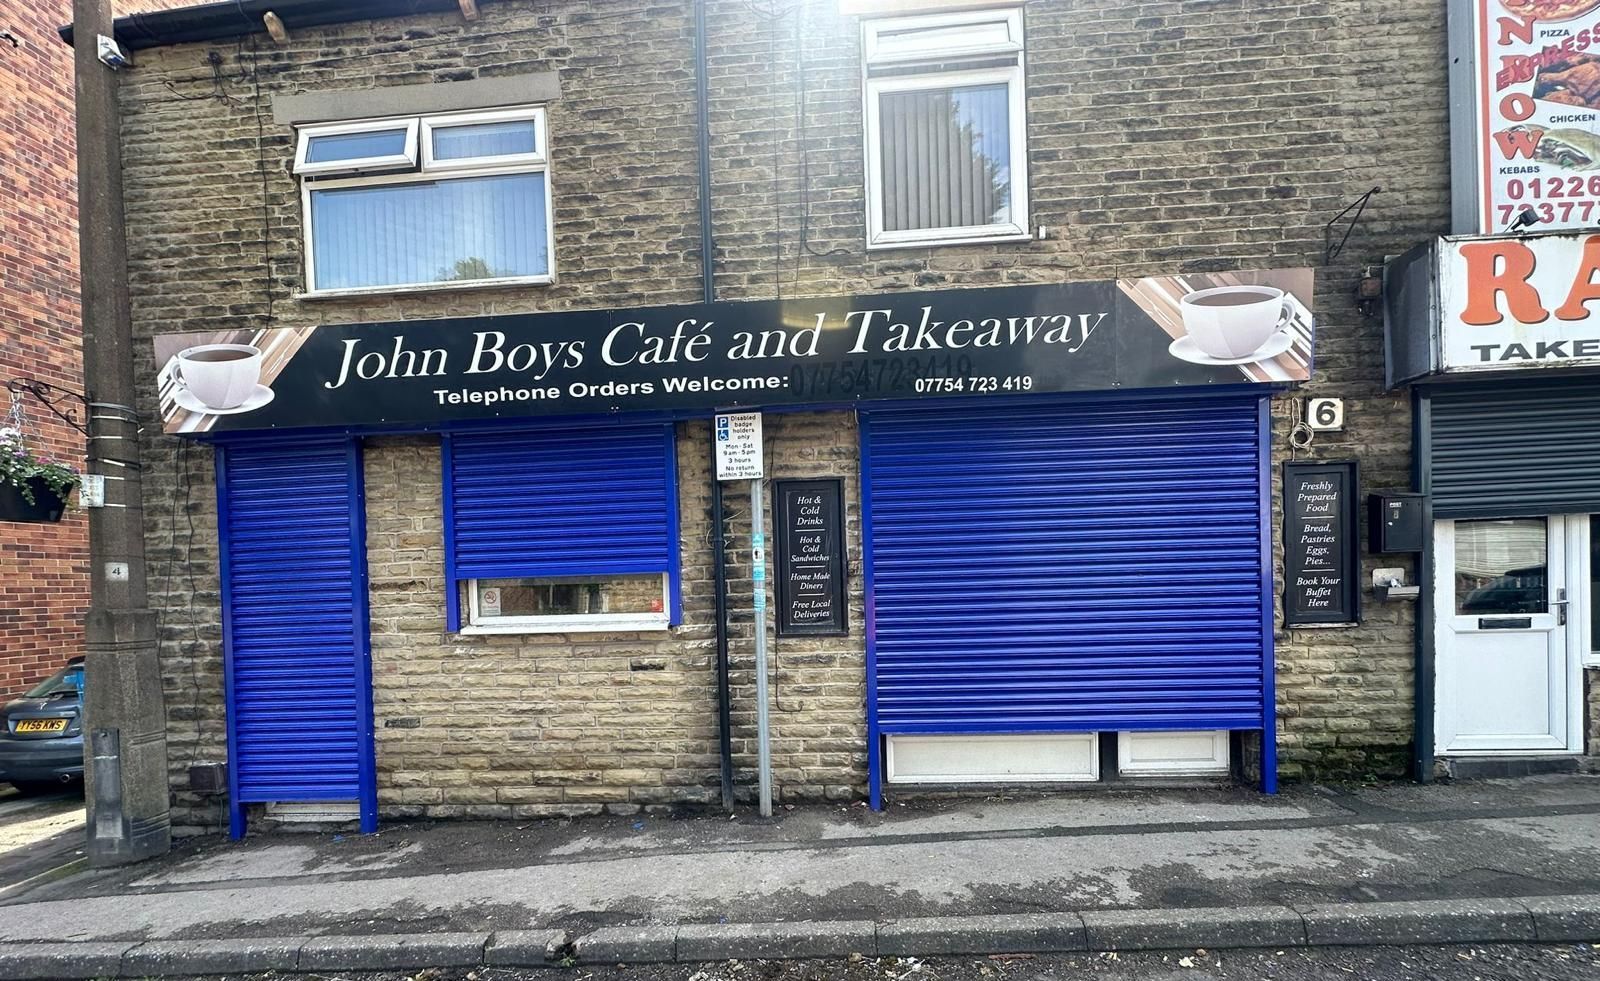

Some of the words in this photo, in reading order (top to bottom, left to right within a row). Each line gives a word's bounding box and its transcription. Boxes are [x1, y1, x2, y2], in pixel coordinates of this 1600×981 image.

[1540, 29, 1570, 38] PIZZA
[1550, 114, 1596, 123] CHICKEN
[1500, 166, 1540, 174] KEBABS
[1507, 175, 1600, 200] 01226
[1498, 201, 1600, 225] 7377
[324, 336, 448, 390] John
[463, 331, 586, 380] Boys
[600, 319, 714, 366] Café
[726, 313, 826, 360] and
[843, 306, 1108, 354] Takeaway
[1470, 339, 1600, 362] TAKE
[915, 377, 964, 393] 07754
[968, 376, 998, 392] 723
[1002, 376, 1033, 391] 419
[434, 385, 560, 406] Telephone
[568, 378, 654, 398] Orders
[662, 374, 790, 394] Welcome:
[1316, 401, 1336, 426] 6
[720, 418, 726, 427] P
[1301, 481, 1333, 491] Freshly
[797, 496, 812, 505] Hot
[814, 496, 822, 504] &
[1298, 492, 1337, 502] Prepared
[800, 506, 820, 515] Cold
[1306, 503, 1328, 512] Food
[797, 517, 824, 526] Drinks
[1301, 535, 1335, 543] Pastries
[802, 545, 820, 553] Cold
[791, 554, 830, 562] Sandwiches
[813, 572, 830, 580] Made
[1296, 577, 1318, 586] Book
[1321, 577, 1340, 585] Your
[1306, 588, 1331, 597] Buffet
[792, 601, 810, 609] Free
[812, 600, 831, 608] Local
[794, 610, 830, 619] Deliveries
